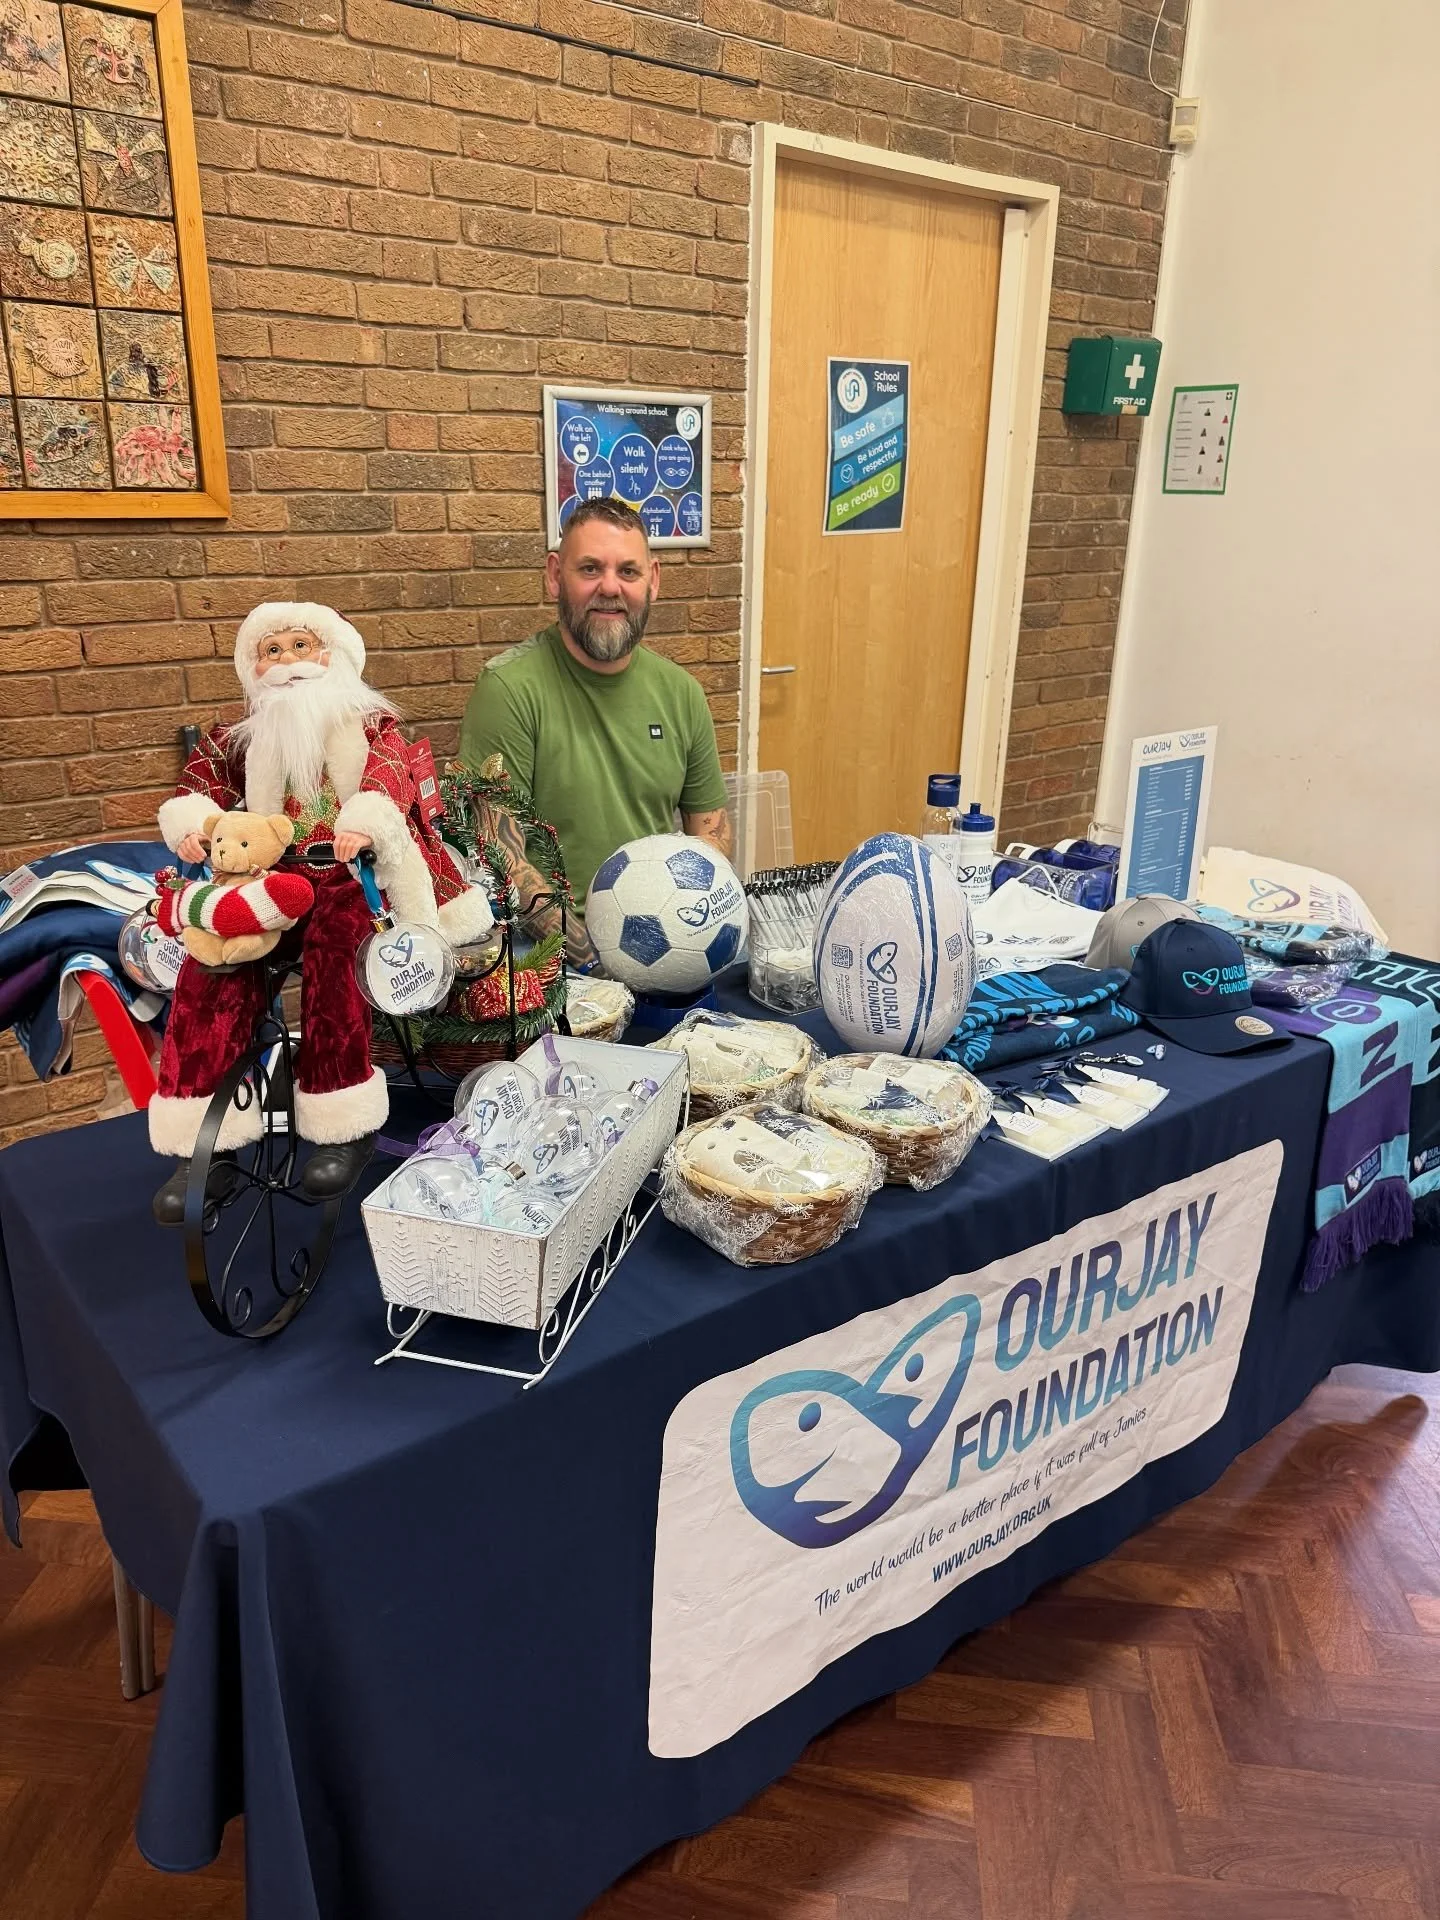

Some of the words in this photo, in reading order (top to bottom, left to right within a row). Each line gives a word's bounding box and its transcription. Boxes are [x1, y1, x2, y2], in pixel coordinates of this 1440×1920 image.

[874, 370, 900, 382] School
[876, 382, 898, 393] Rules
[597, 404, 625, 415] Walking
[625, 407, 648, 415] around
[1112, 396, 1134, 405] FIRST
[1133, 397, 1147, 406] AID
[567, 423, 584, 432] Walk
[569, 432, 580, 441] the
[580, 433, 591, 441] left
[840, 435, 855, 449] Be
[855, 421, 876, 440] safe
[623, 445, 646, 458] Walk
[857, 454, 868, 464] Be
[868, 443, 883, 458] kind
[883, 434, 898, 450] and
[862, 448, 898, 474] respectful
[578, 470, 591, 478] One
[592, 470, 611, 478] behind
[620, 461, 649, 477] silently
[836, 502, 850, 516] Be
[851, 485, 880, 508] ready
[390, 960, 427, 990] OURJAY
[390, 968, 435, 1004] FOUNDATION
[867, 979, 885, 1035] FOUNDATION
[882, 987, 902, 1030] OURJAY
[994, 1192, 1217, 1372] OURJAY
[946, 1286, 1224, 1492] FOUNDATION
[814, 1588, 840, 1616] The
[846, 1555, 884, 1595] world
[888, 1532, 925, 1569] would
[928, 1527, 944, 1547] be
[948, 1522, 955, 1534] a
[960, 1496, 997, 1528] better
[1000, 1478, 1029, 1511] place
[1033, 1469, 1042, 1490] if
[1045, 1458, 1054, 1477] it
[1056, 1450, 1075, 1470] was
[1078, 1431, 1097, 1463] full
[1099, 1430, 1111, 1448] of
[1113, 1407, 1147, 1438] Jamies
[932, 1493, 1052, 1582] WWW.OURJAY.ORG.UK
